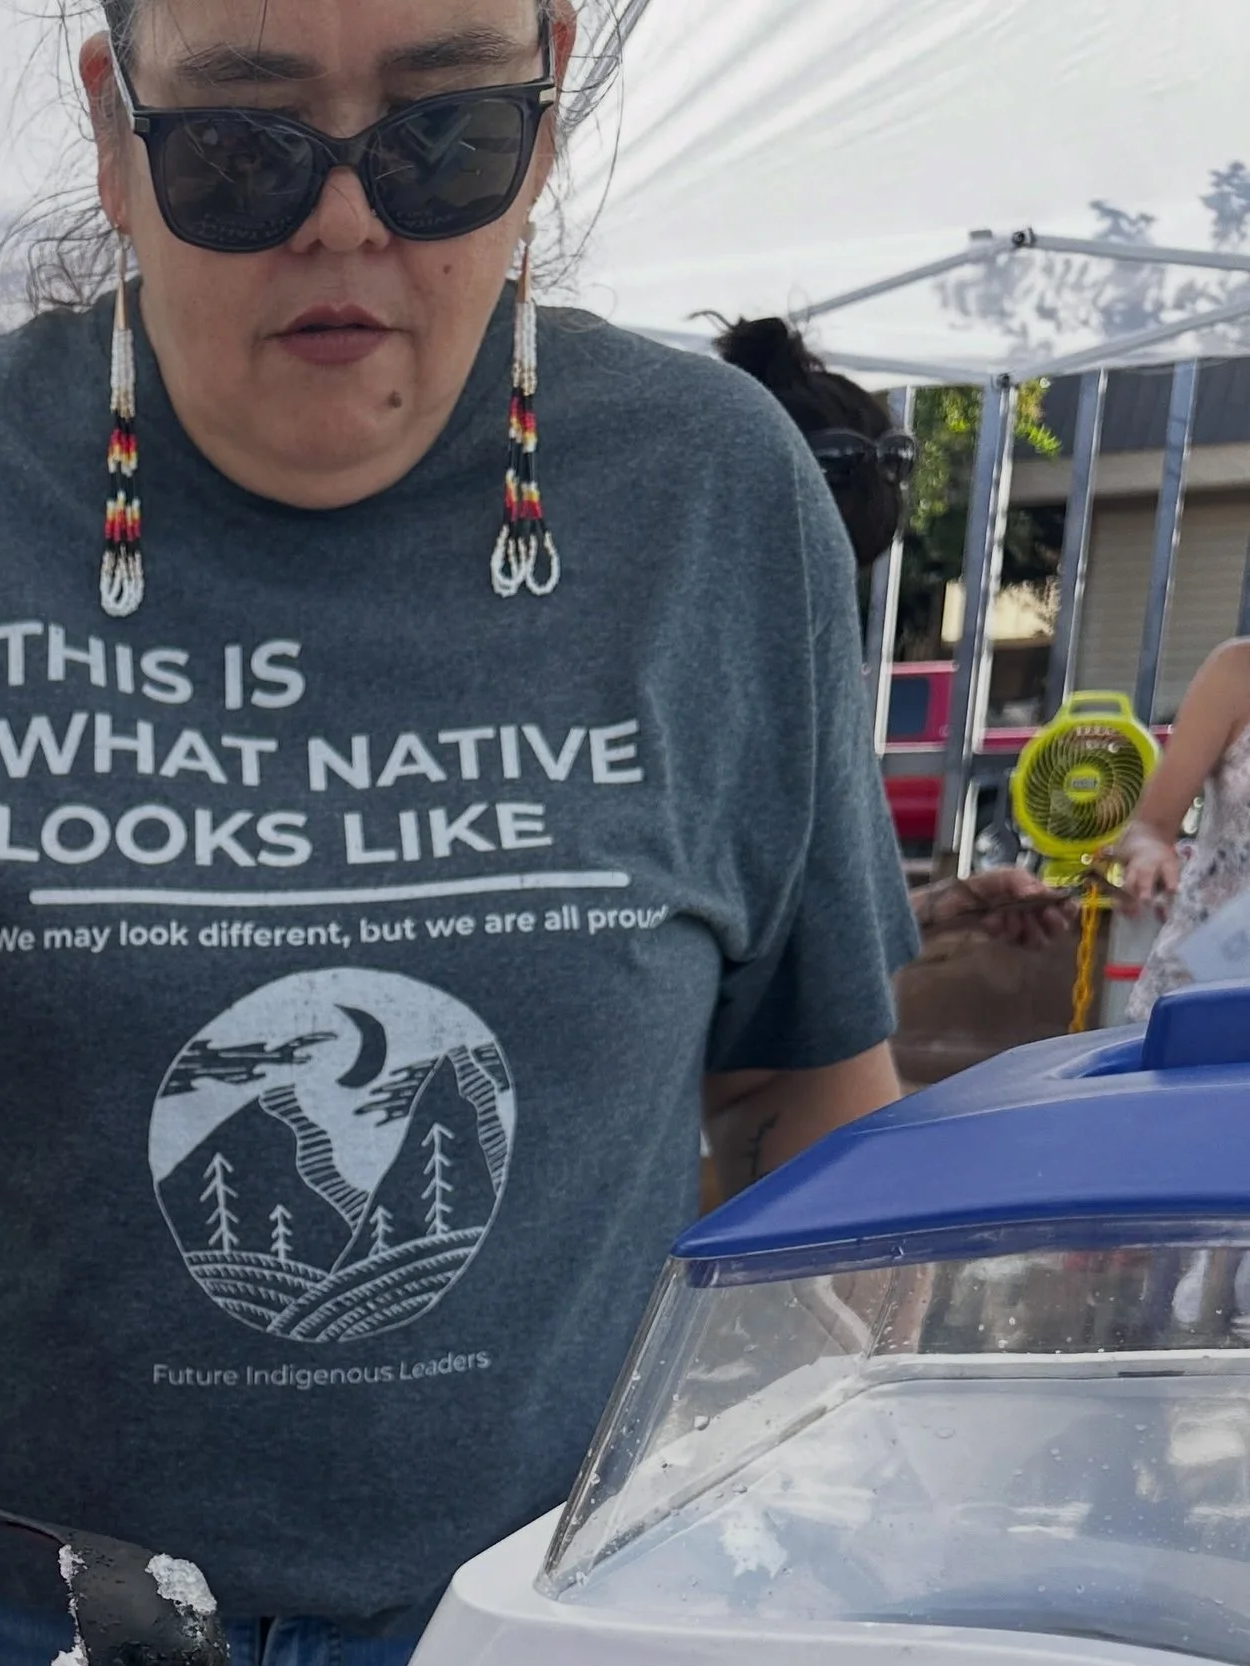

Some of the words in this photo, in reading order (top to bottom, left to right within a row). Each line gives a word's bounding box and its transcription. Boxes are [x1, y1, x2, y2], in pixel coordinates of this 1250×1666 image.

[224, 639, 306, 710] IS
[306, 719, 645, 792] NATIVE
[342, 801, 554, 866] LIKE
[43, 926, 112, 954] may
[119, 919, 190, 947] look
[197, 920, 352, 949] different,
[359, 917, 418, 944] but
[425, 915, 477, 939] we
[484, 911, 537, 934] are
[544, 904, 581, 932] all
[152, 1362, 238, 1387] Future
[246, 1362, 396, 1391] Indigenous
[399, 1349, 493, 1382] Leaders
